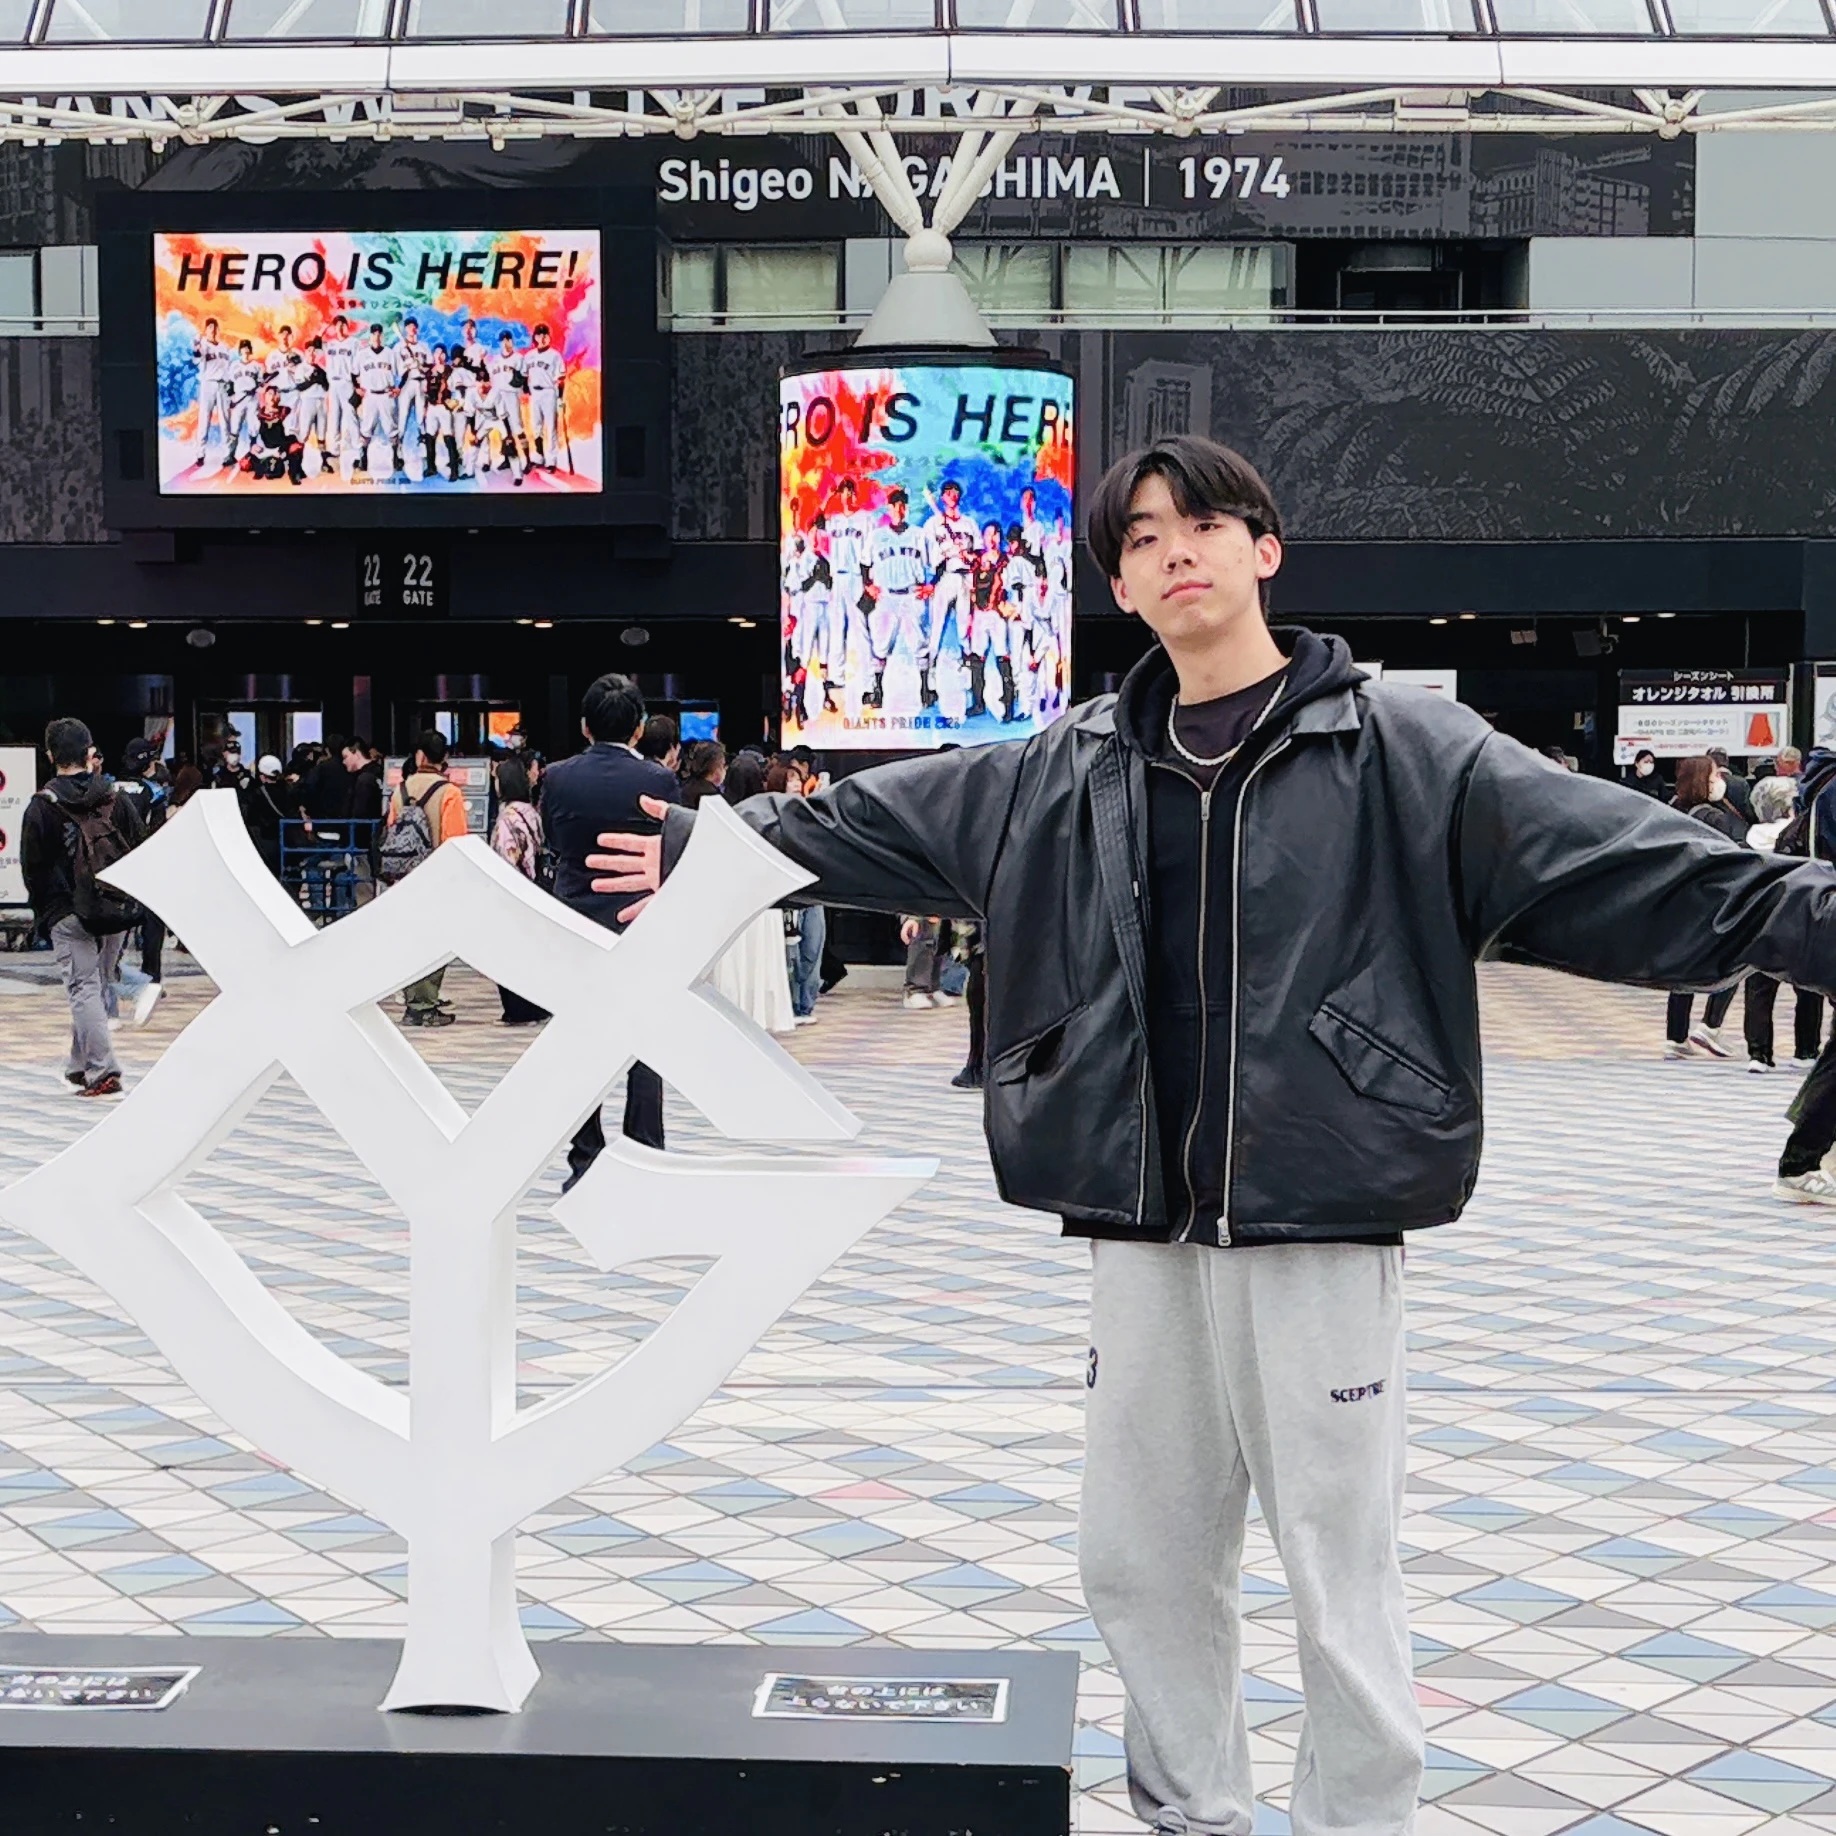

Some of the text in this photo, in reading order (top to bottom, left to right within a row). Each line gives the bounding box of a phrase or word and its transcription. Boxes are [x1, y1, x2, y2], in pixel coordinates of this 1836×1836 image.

[659, 157, 813, 212] Shigeo
[827, 155, 1121, 199] NGAHIMA
[1178, 156, 1291, 199] 1974
[177, 250, 580, 292] HERO IS HERE!
[858, 392, 920, 443] IS
[364, 553, 380, 587] 22
[403, 553, 433, 587] 22
[402, 589, 434, 607] GATE
[1632, 686, 1727, 702] オレンジタオル
